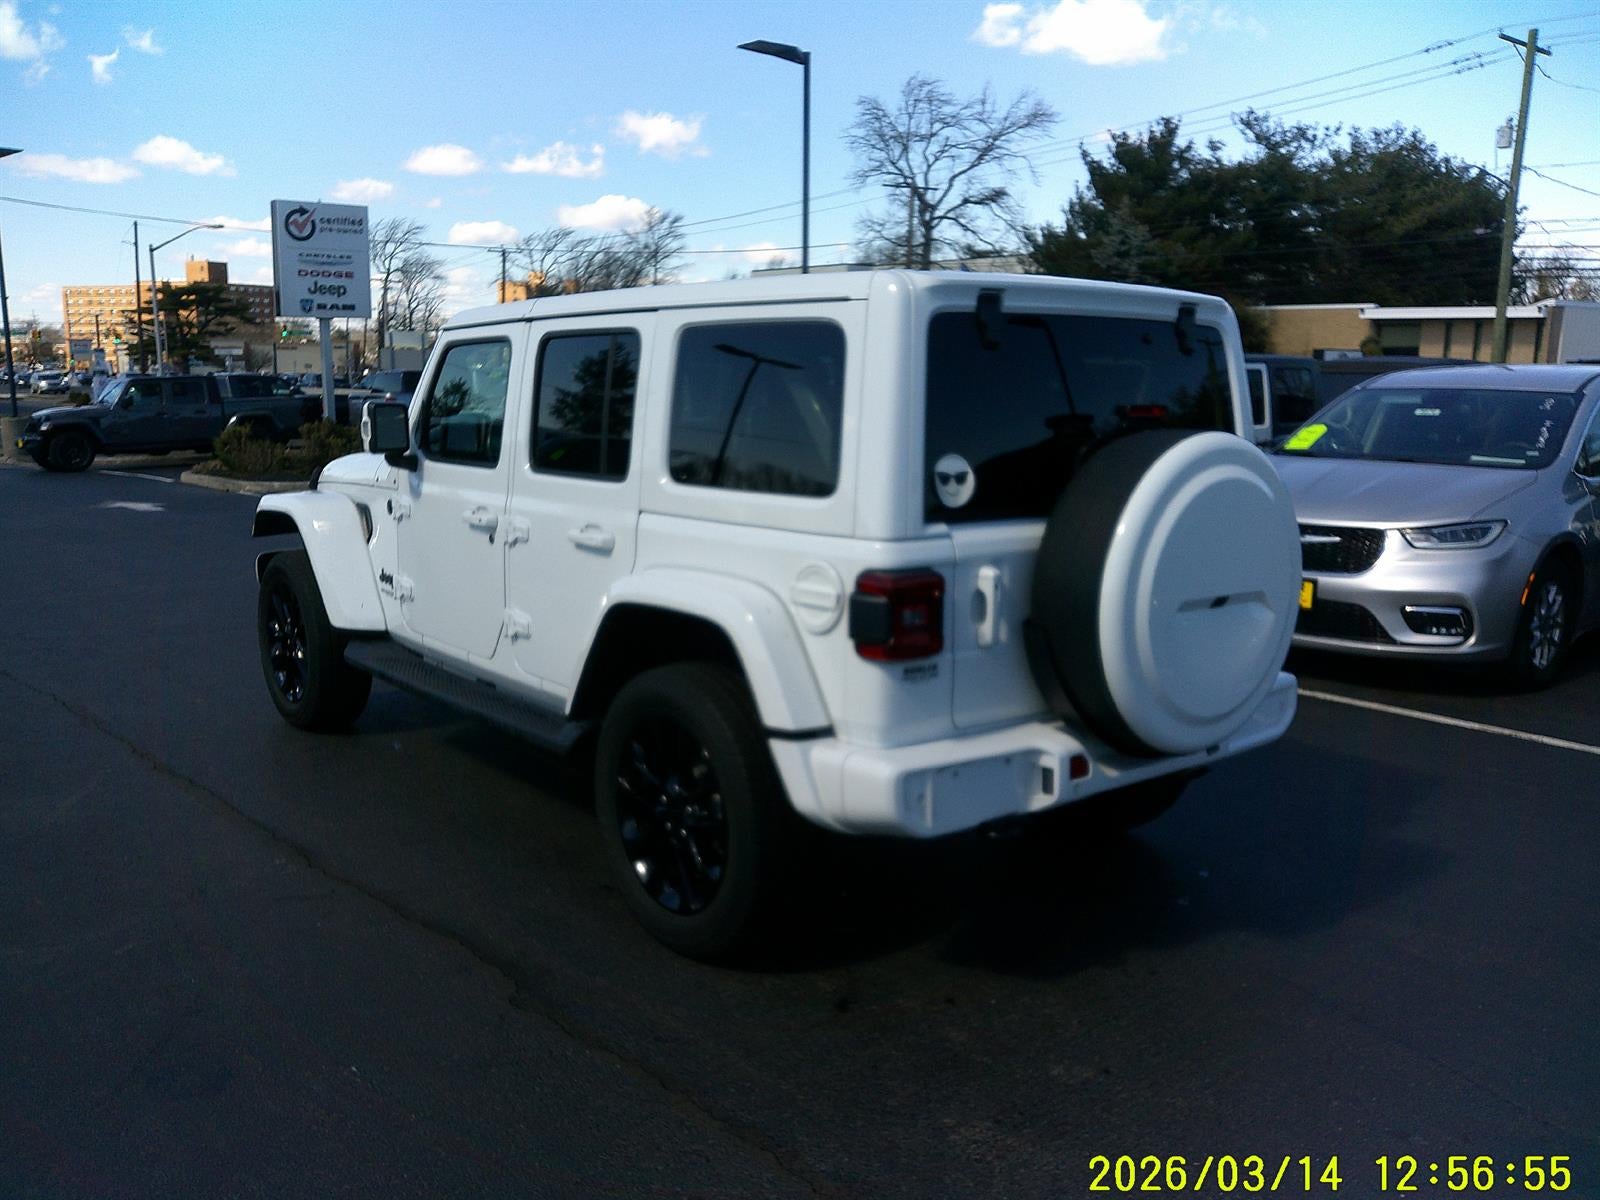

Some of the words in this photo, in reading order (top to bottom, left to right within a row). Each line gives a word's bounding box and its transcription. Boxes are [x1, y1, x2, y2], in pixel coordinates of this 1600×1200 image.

[297, 268, 354, 279] DODGE
[307, 280, 347, 298] Jeep
[316, 302, 356, 311] RAM
